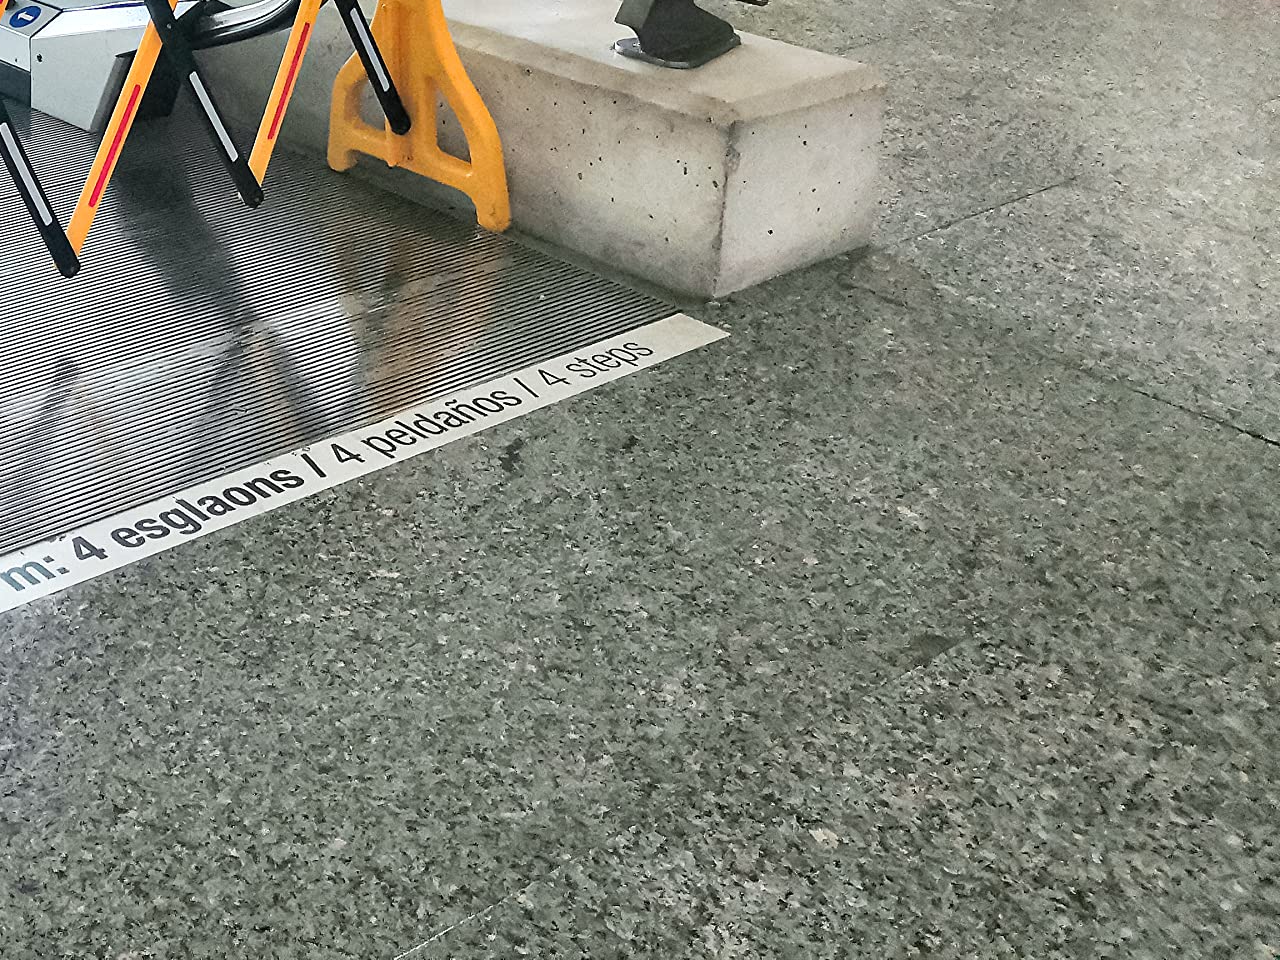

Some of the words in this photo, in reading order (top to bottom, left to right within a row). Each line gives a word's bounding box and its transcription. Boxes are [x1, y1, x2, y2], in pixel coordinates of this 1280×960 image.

[71, 535, 108, 561] 4
[111, 468, 305, 548] esglaons
[300, 453, 327, 478] /
[331, 443, 365, 465] 4
[361, 389, 522, 459] peldaños
[513, 377, 540, 398] /
[537, 368, 570, 387] 4
[566, 341, 654, 378] steps
